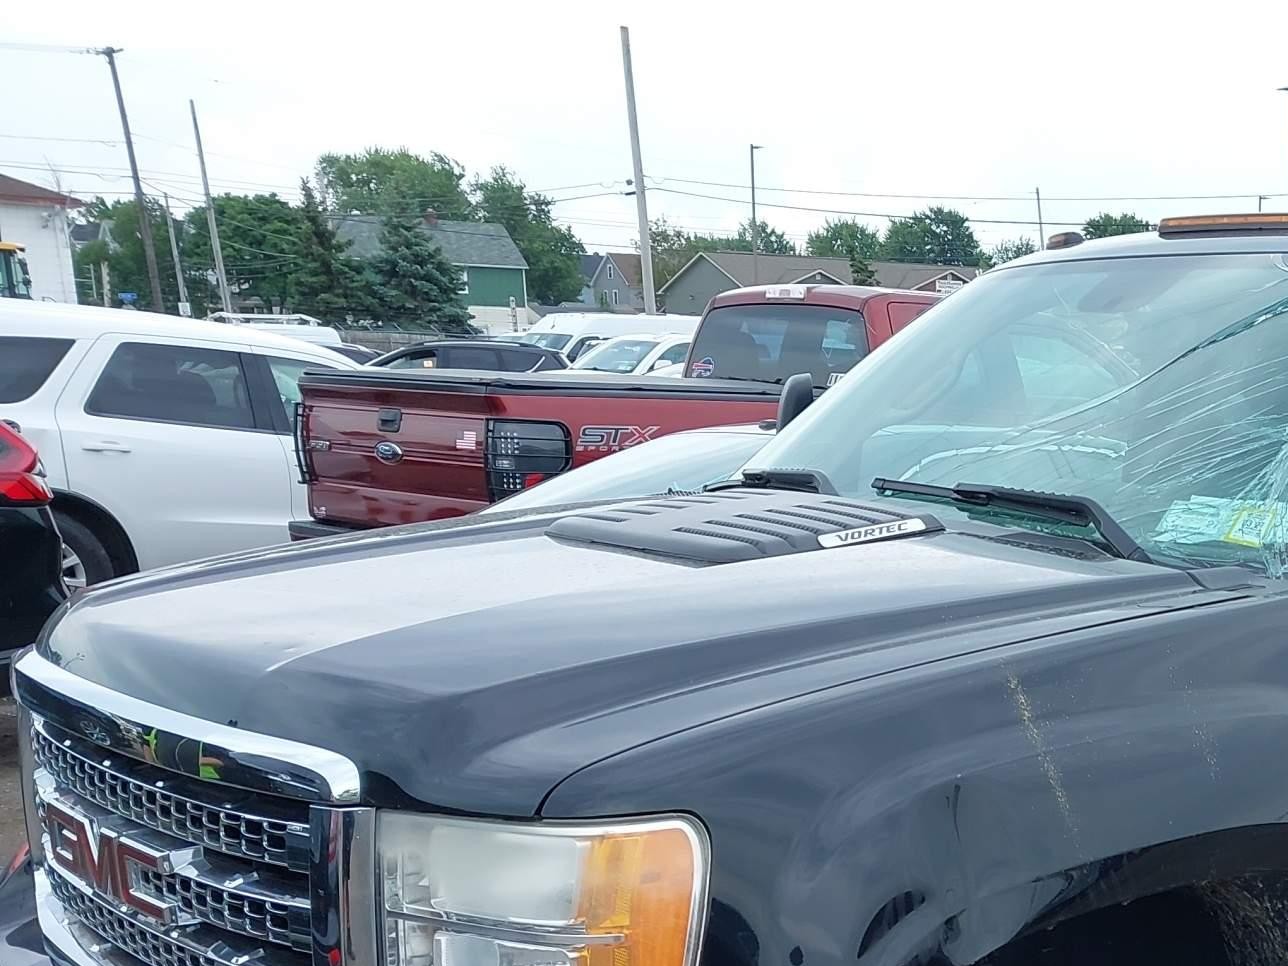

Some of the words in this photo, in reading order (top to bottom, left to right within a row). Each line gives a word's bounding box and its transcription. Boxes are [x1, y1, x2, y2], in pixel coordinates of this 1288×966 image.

[577, 425, 660, 445] STX
[835, 522, 908, 542] VORTEC
[46, 798, 178, 926] GMC
